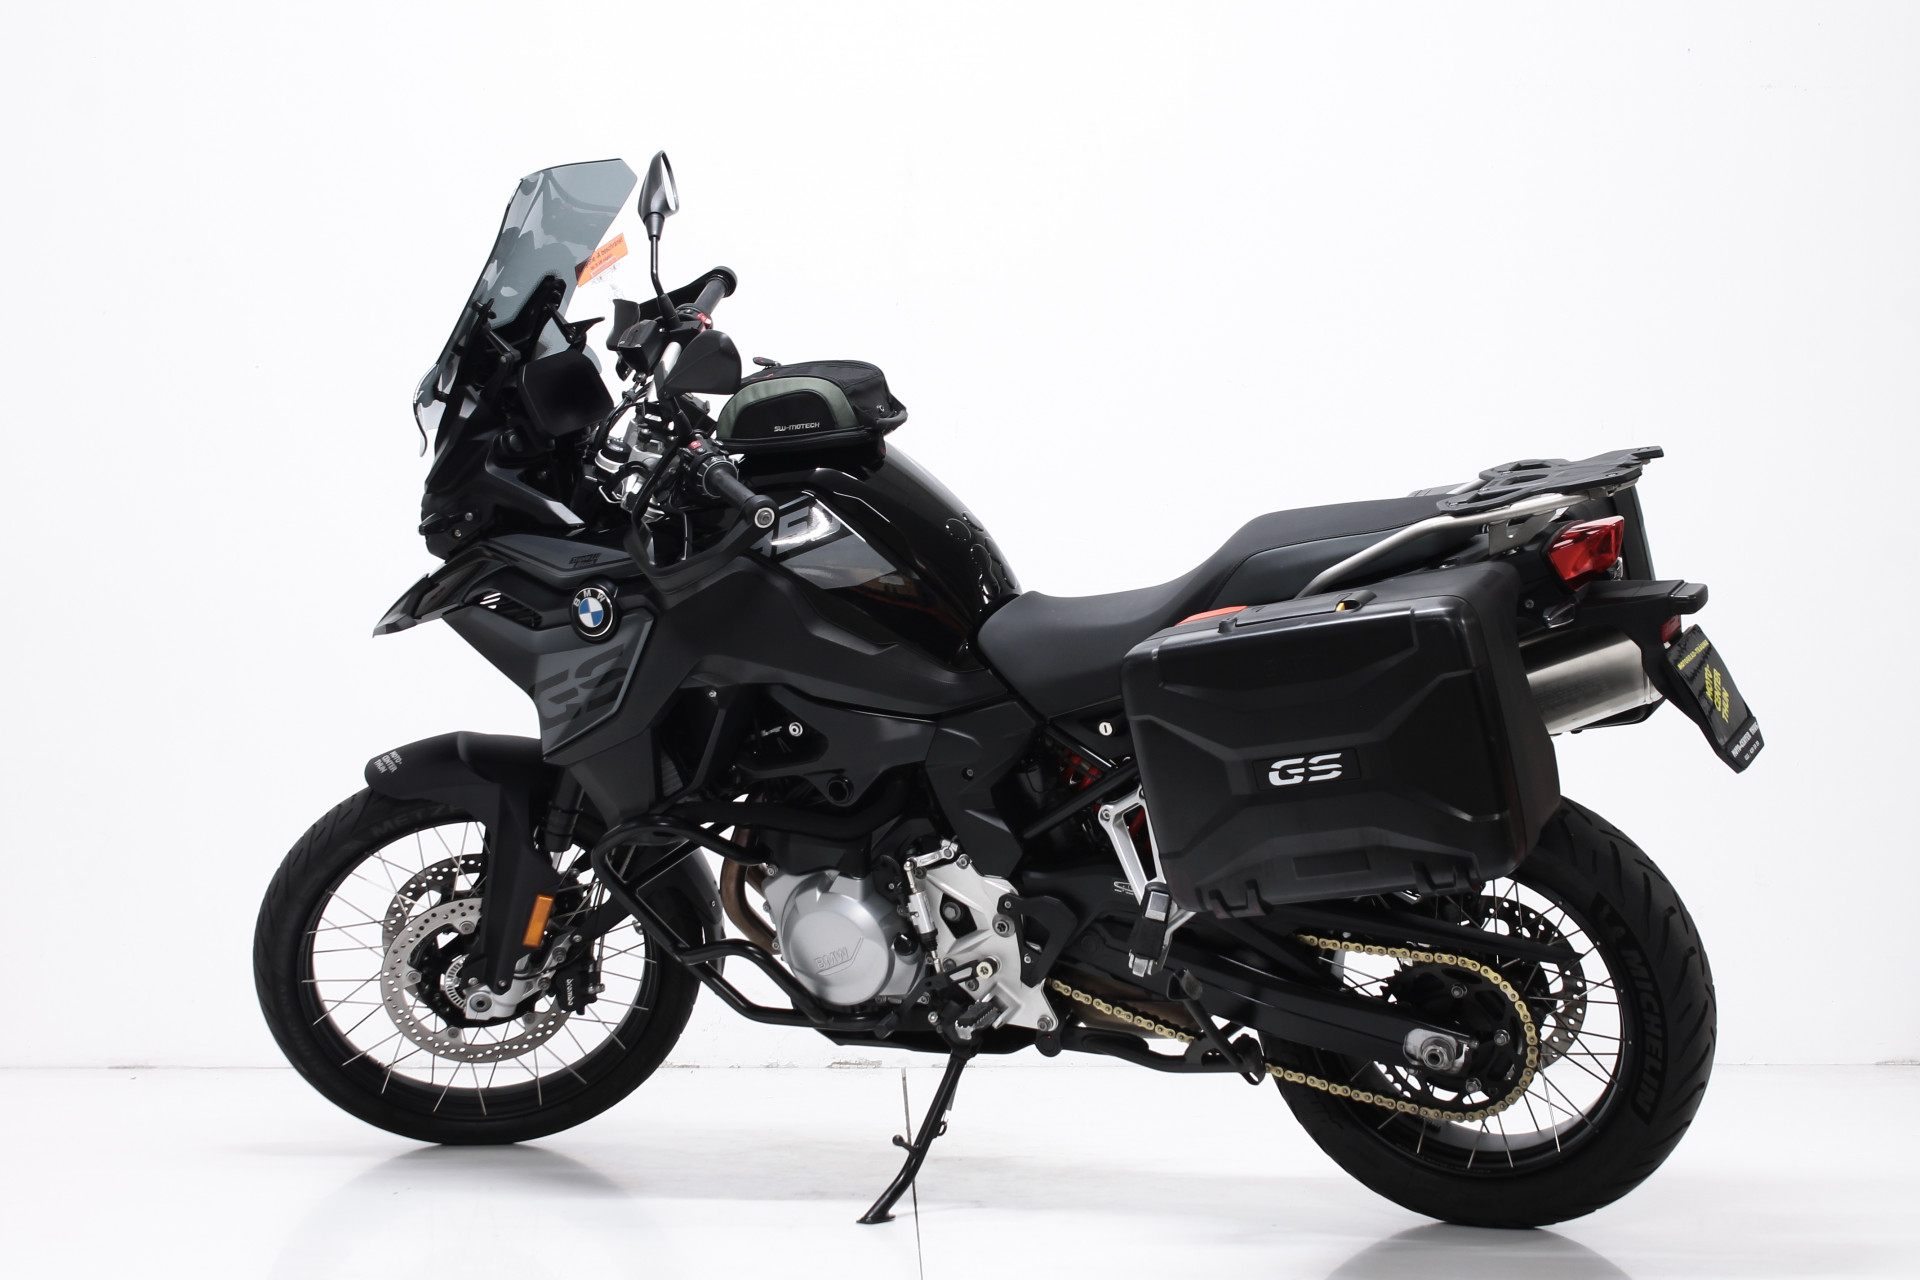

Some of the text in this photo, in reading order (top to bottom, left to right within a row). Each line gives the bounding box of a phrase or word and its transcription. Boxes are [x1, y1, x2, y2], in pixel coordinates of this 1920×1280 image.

[773, 421, 820, 432] SW-MOTECH
[573, 589, 606, 607] BMW
[533, 643, 628, 731] GS
[1705, 664, 1714, 701] MOTO-
[1713, 668, 1722, 712] CENTER
[1721, 687, 1730, 724] THUN
[381, 754, 398, 773] CENTER
[1268, 752, 1342, 786] GS
[814, 946, 850, 970] BMW
[566, 978, 576, 1006] brembo
[1620, 949, 1664, 1113] MICHELIN
